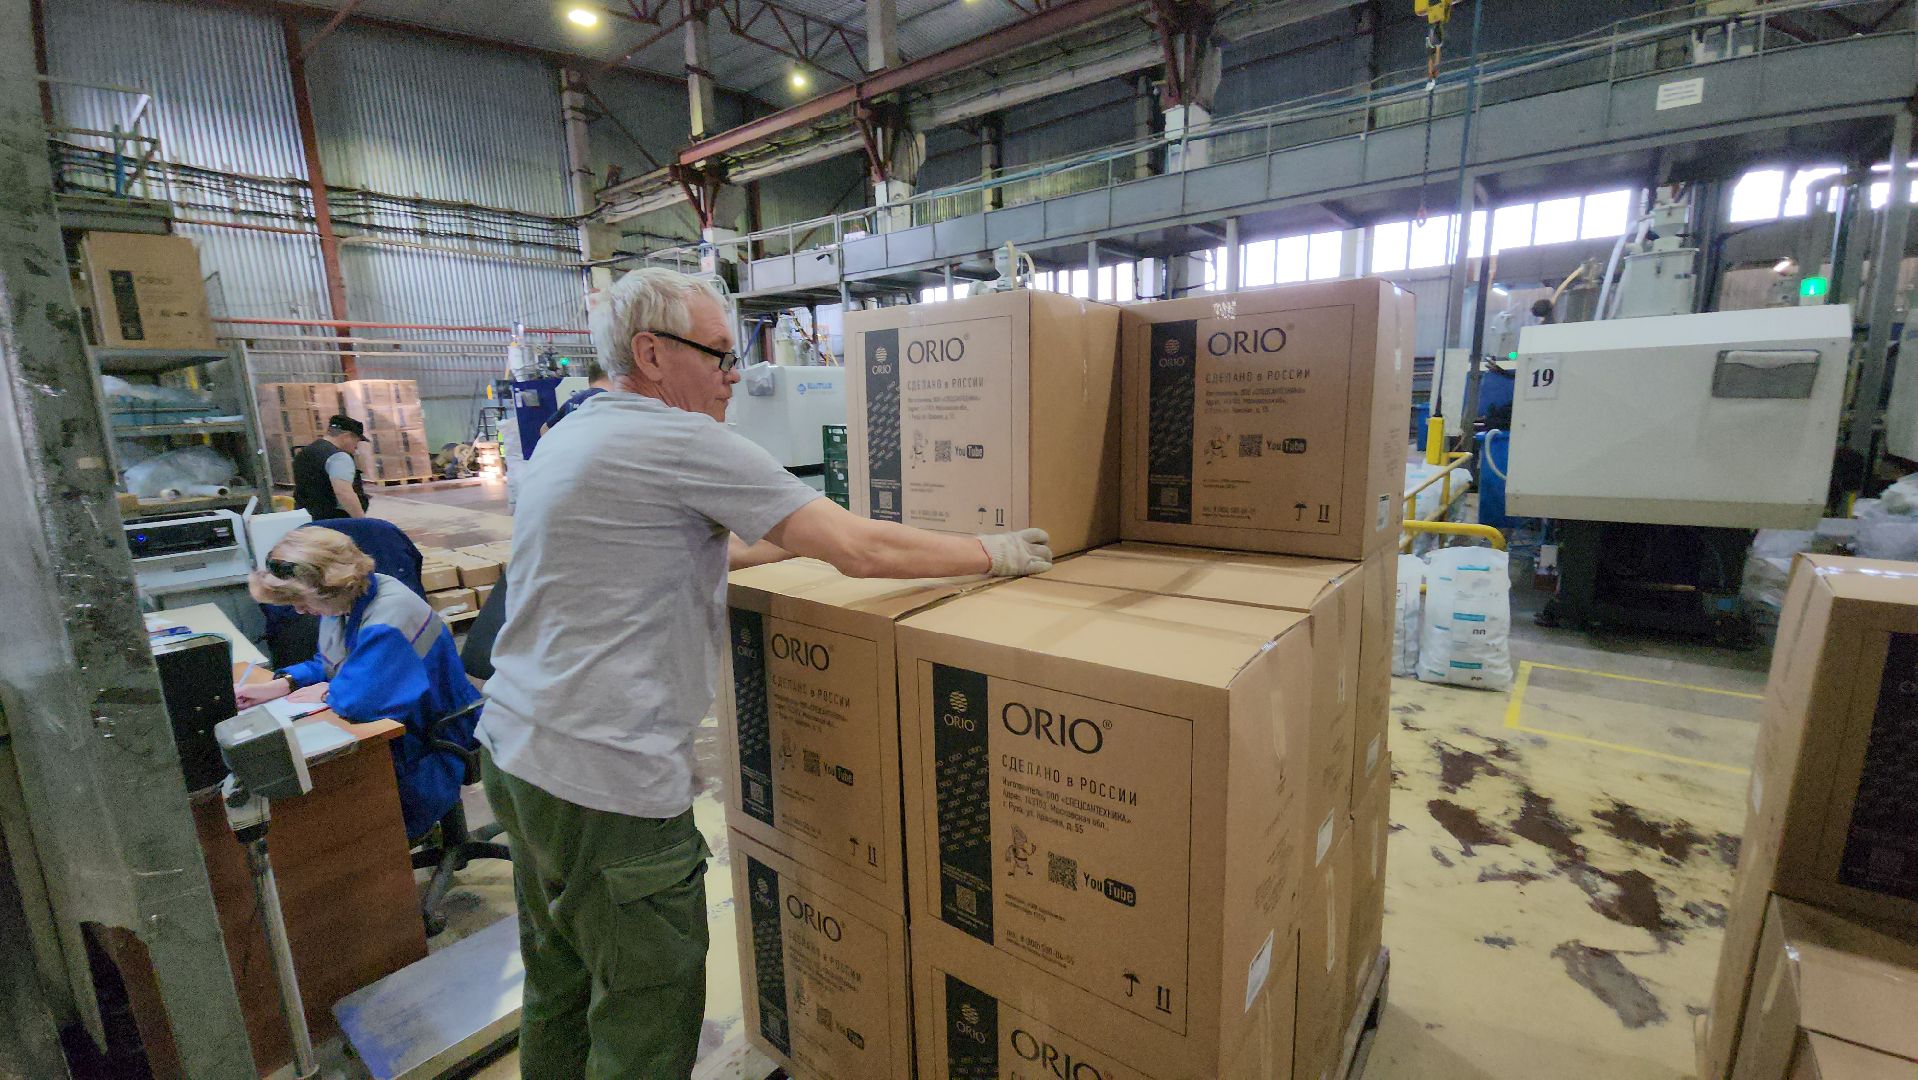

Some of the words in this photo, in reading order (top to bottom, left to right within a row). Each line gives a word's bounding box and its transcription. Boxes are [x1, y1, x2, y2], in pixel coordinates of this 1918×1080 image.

[1532, 368, 1554, 387] 19
[944, 713, 975, 732] ORIO
[1002, 754, 1060, 783] СДЕЛАНО
[1066, 777, 1074, 787] в
[1080, 776, 1137, 807] РОССИИ
[1083, 871, 1137, 907] YouTube
